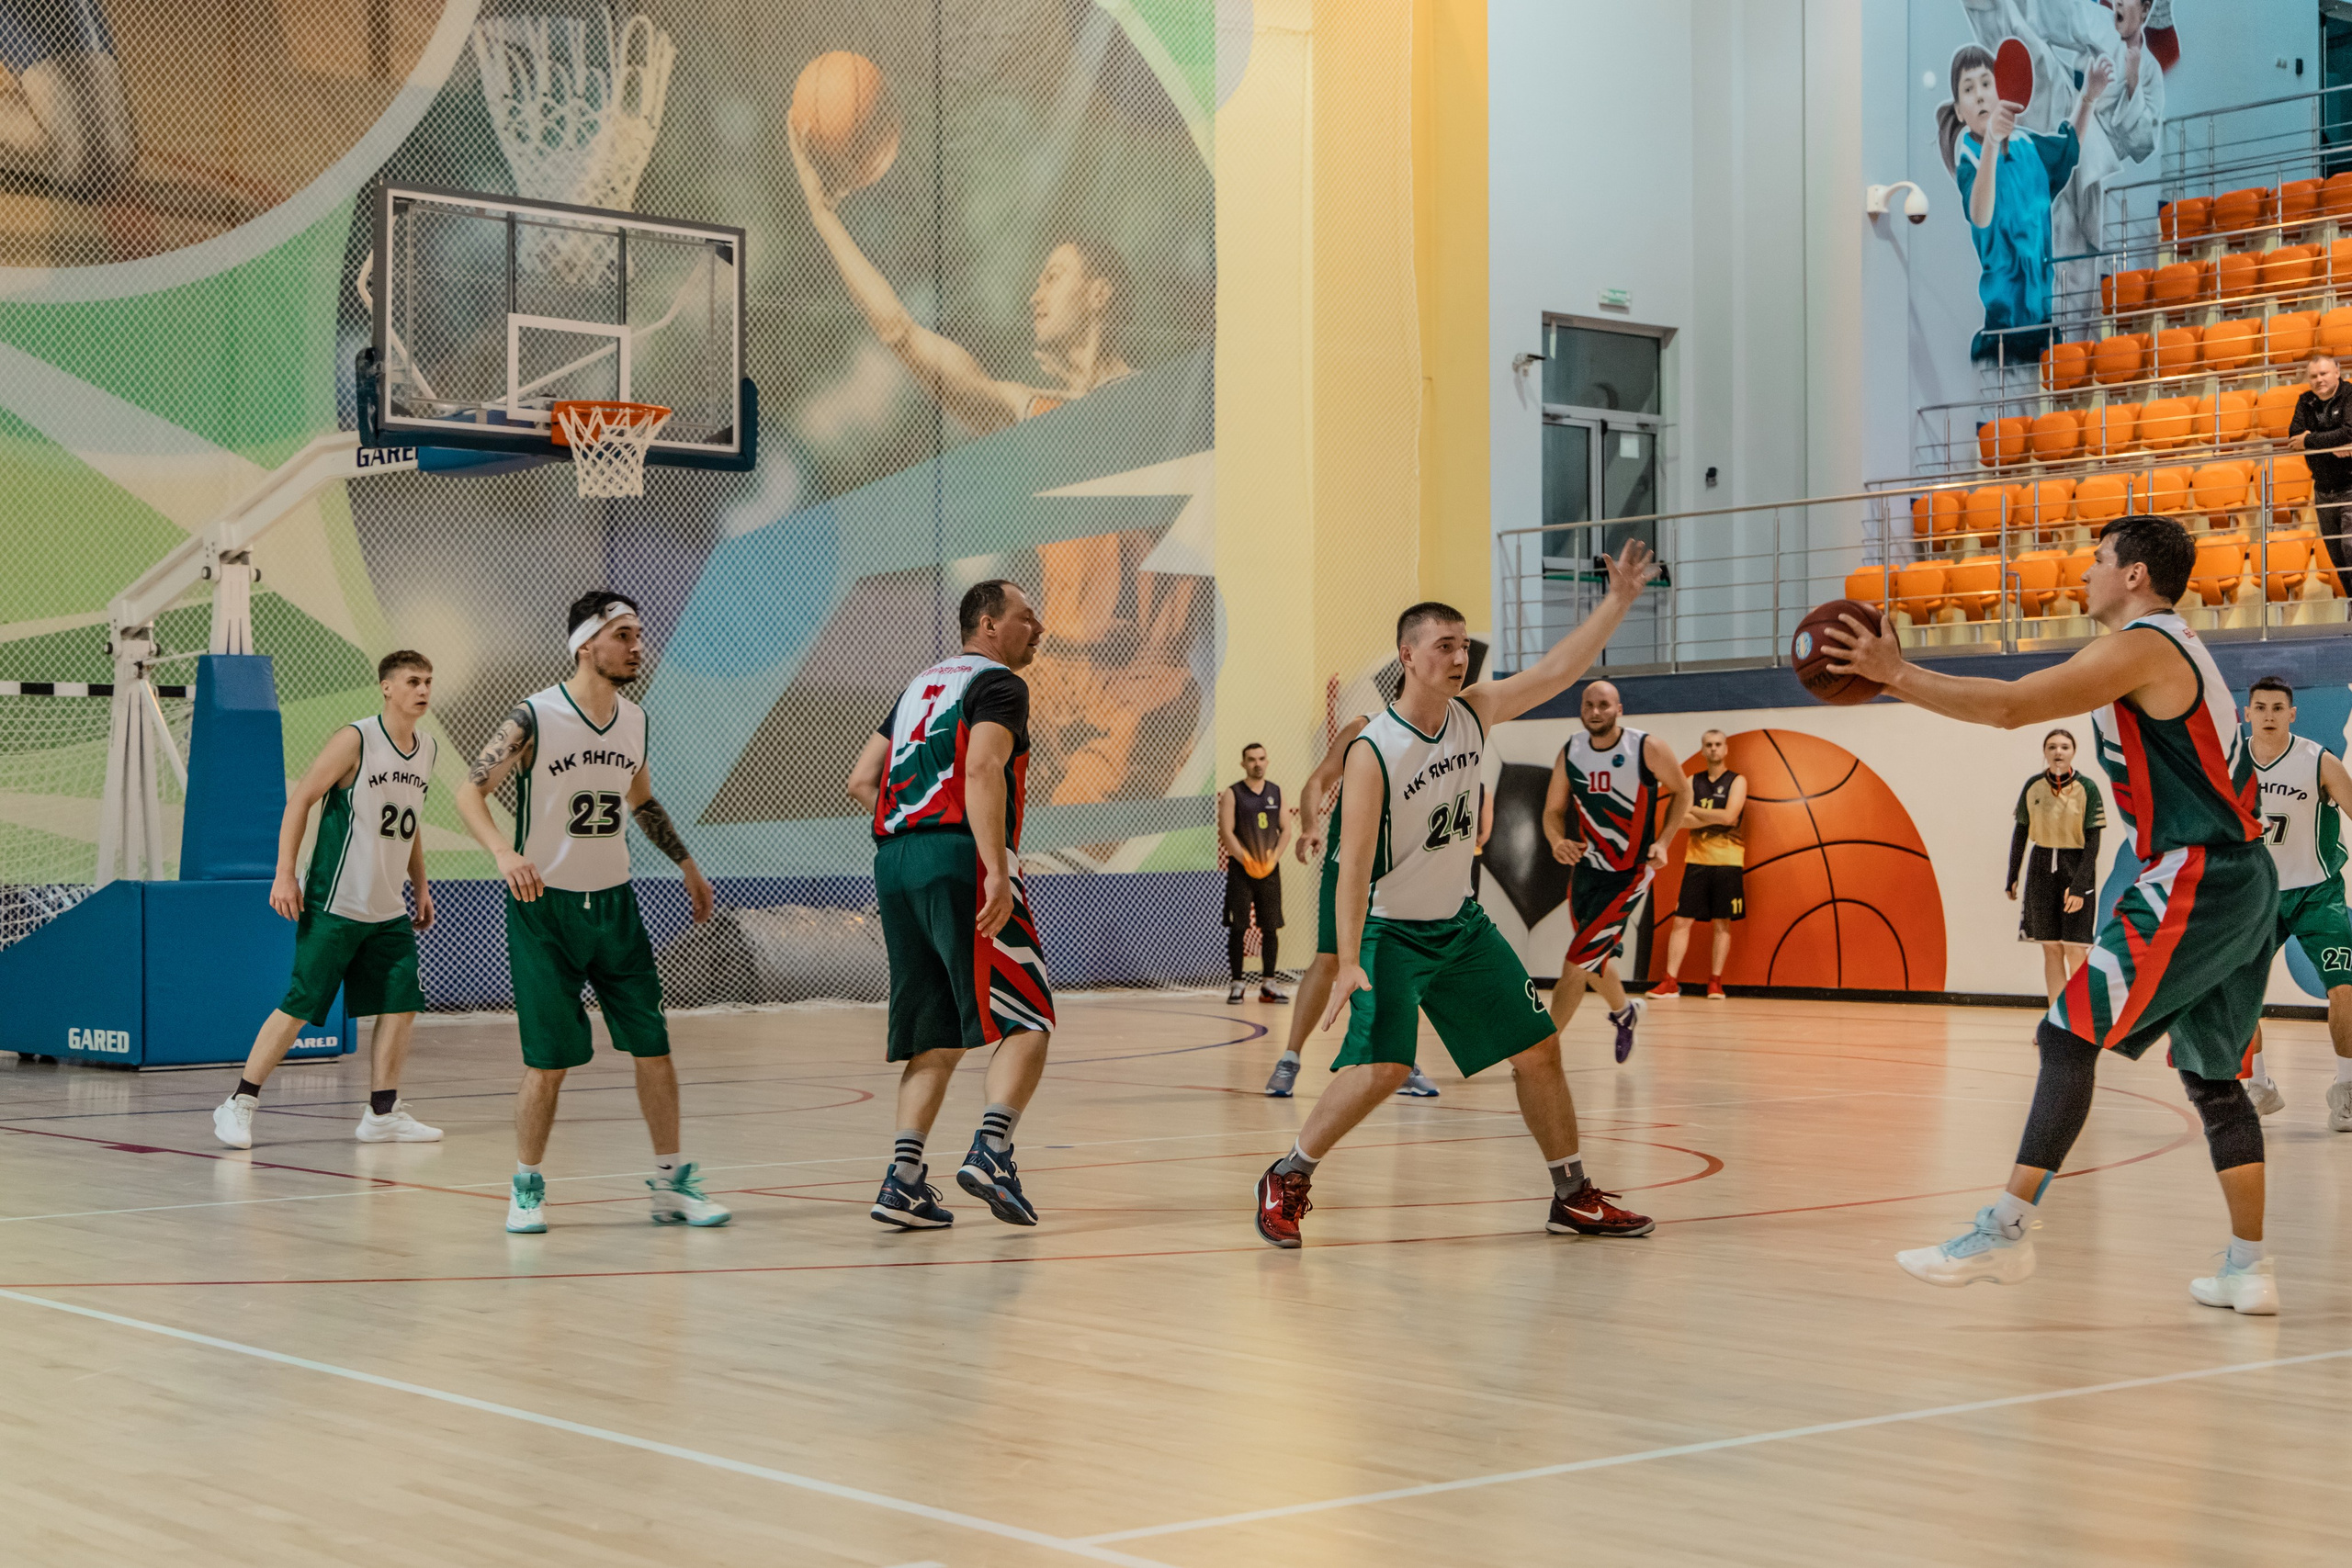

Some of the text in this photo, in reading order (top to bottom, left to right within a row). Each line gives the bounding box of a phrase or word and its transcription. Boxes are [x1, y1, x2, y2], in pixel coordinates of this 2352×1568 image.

[909, 684, 946, 743] 7
[548, 752, 577, 776] НК
[368, 772, 388, 788] НК
[1403, 771, 1426, 800] НК
[1589, 770, 1611, 794] 10
[2259, 783, 2308, 800] НГПУР
[566, 790, 622, 838] 23
[1700, 797, 1713, 810] 11
[379, 802, 418, 841] 20
[1258, 812, 1268, 829] 8
[1422, 790, 1474, 852] 24
[2259, 813, 2290, 846] 7
[1731, 897, 1743, 914] 11
[2322, 947, 2351, 971] 27
[68, 1027, 130, 1054] GARED
[288, 1036, 338, 1049] ARED
